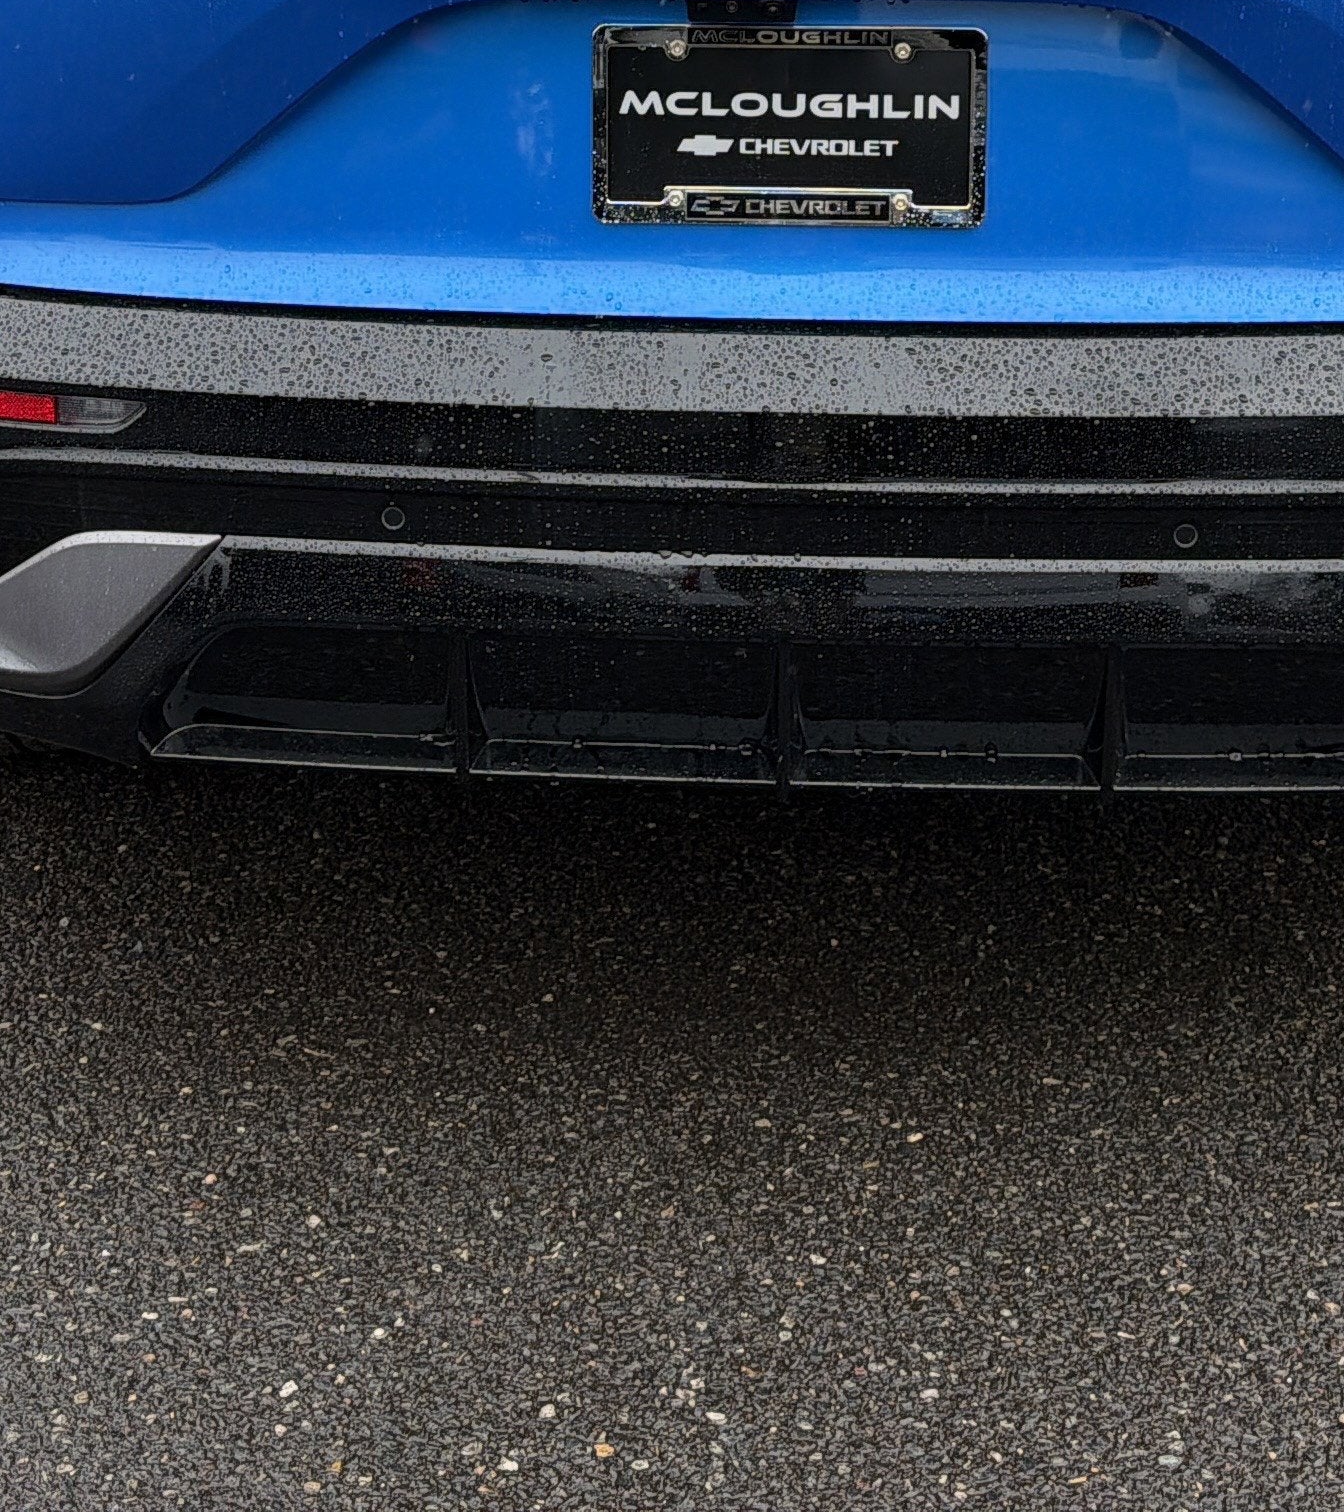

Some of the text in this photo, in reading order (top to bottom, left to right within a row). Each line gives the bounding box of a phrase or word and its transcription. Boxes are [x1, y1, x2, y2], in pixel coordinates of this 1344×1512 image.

[690, 28, 891, 46] MCLOUGHLIN
[618, 90, 961, 120] MCLOUGHLIN
[738, 138, 900, 157] CHEVROLET
[744, 198, 888, 217] CHEVROLET
